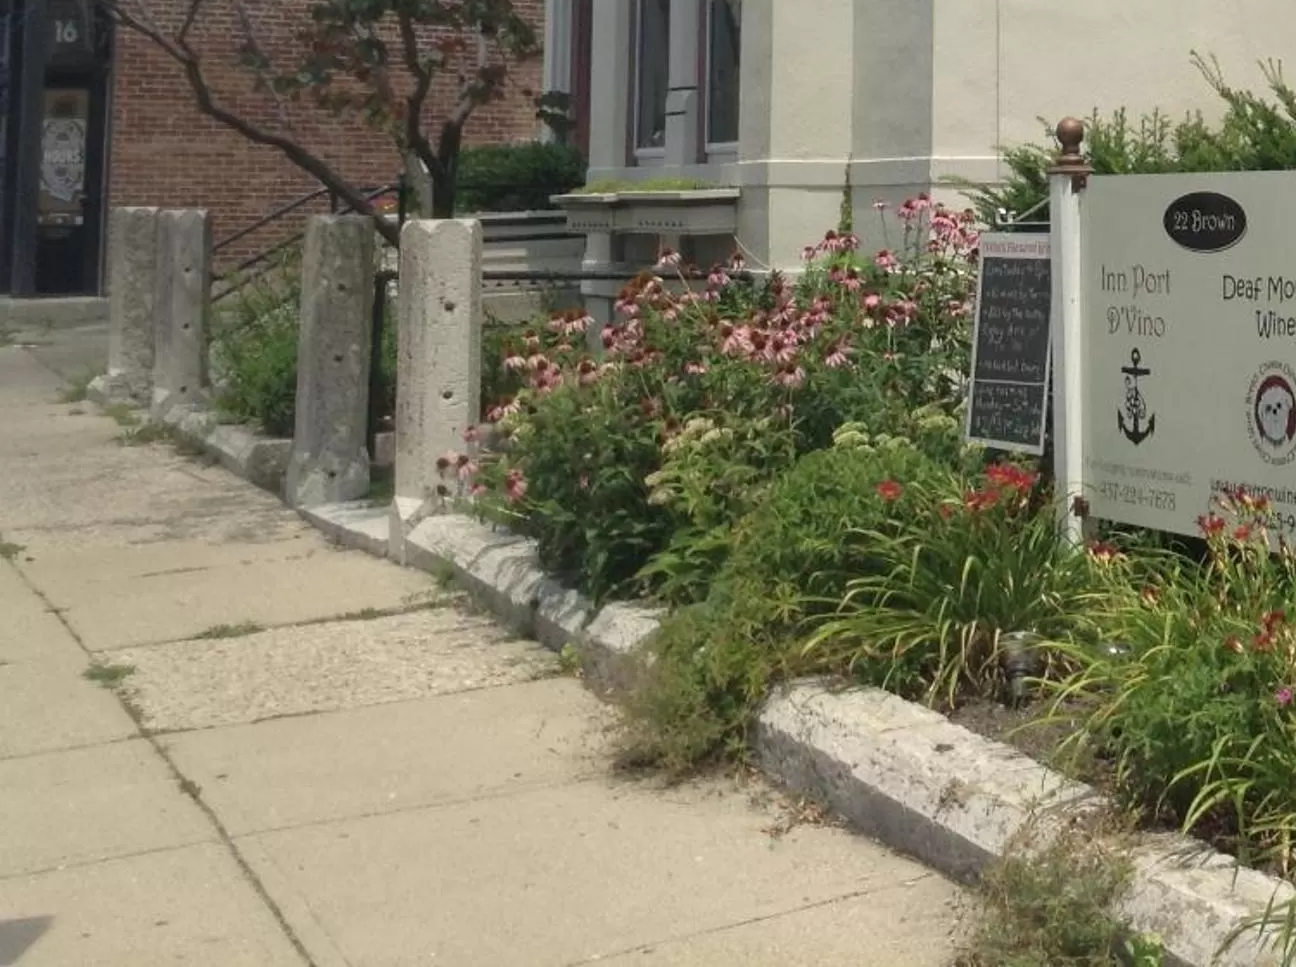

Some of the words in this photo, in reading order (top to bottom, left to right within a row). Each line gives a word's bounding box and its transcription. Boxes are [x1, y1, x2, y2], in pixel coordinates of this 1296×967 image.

[54, 19, 78, 43] 16
[1173, 211, 1189, 231] 22
[1191, 209, 1236, 233] Brown
[1100, 264, 1128, 293] Inn
[1130, 263, 1172, 300] Port
[1222, 274, 1264, 301] Deaf
[1106, 305, 1168, 338] D'Vino
